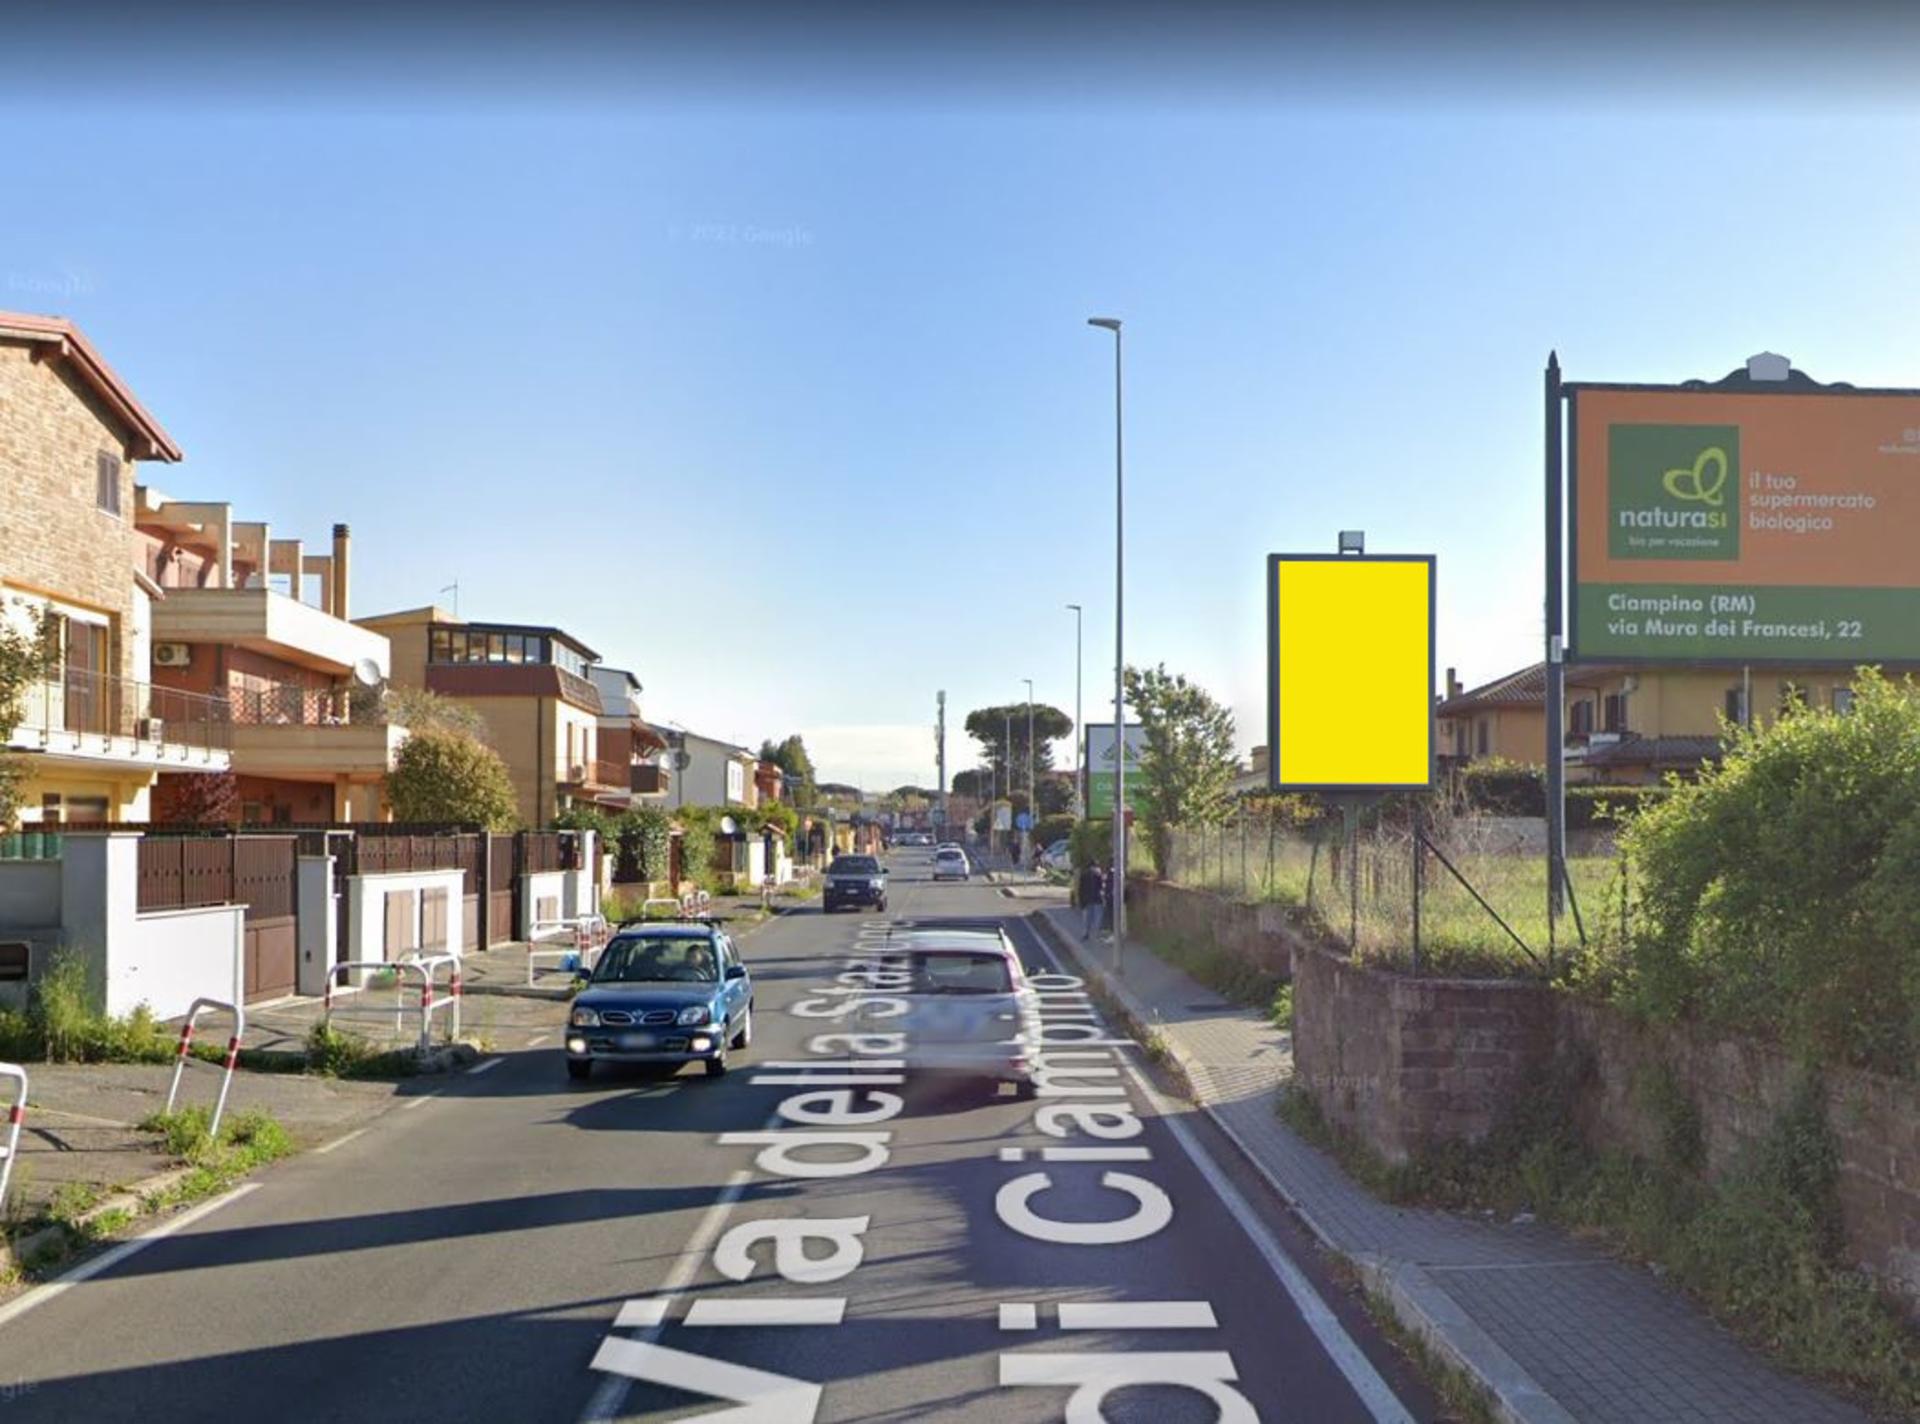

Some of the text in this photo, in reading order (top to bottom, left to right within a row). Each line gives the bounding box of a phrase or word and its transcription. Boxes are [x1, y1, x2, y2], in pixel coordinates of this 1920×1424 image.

[1749, 471, 1796, 490] il tuo
[1749, 493, 1876, 510] supermercato
[1749, 512, 1833, 533] biologico
[1608, 594, 1755, 615] Ciampino (RM)
[1607, 619, 1863, 640] via Mura dei Francesi, 22
